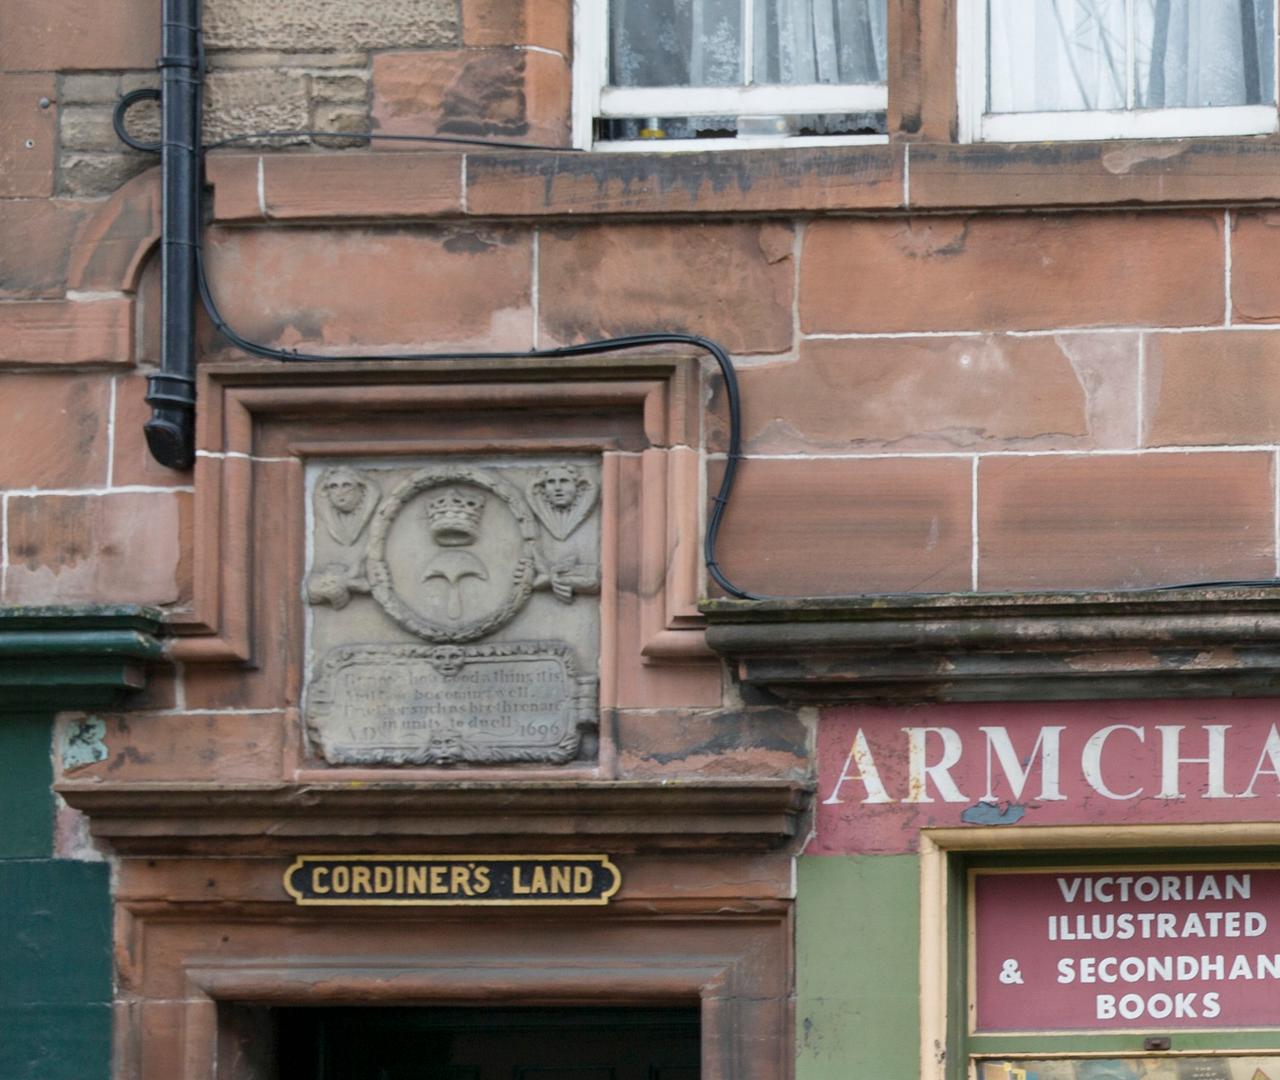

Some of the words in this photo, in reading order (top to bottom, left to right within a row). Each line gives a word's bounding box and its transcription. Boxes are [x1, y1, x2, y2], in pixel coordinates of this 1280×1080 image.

[312, 863, 492, 896] CORDINER'S
[512, 865, 594, 895] LAND
[1056, 873, 1252, 903] VICTORIAN
[1047, 911, 1268, 941] ILLUSTRATED
[999, 957, 1025, 985] &
[1095, 992, 1222, 1020] BOOKS
